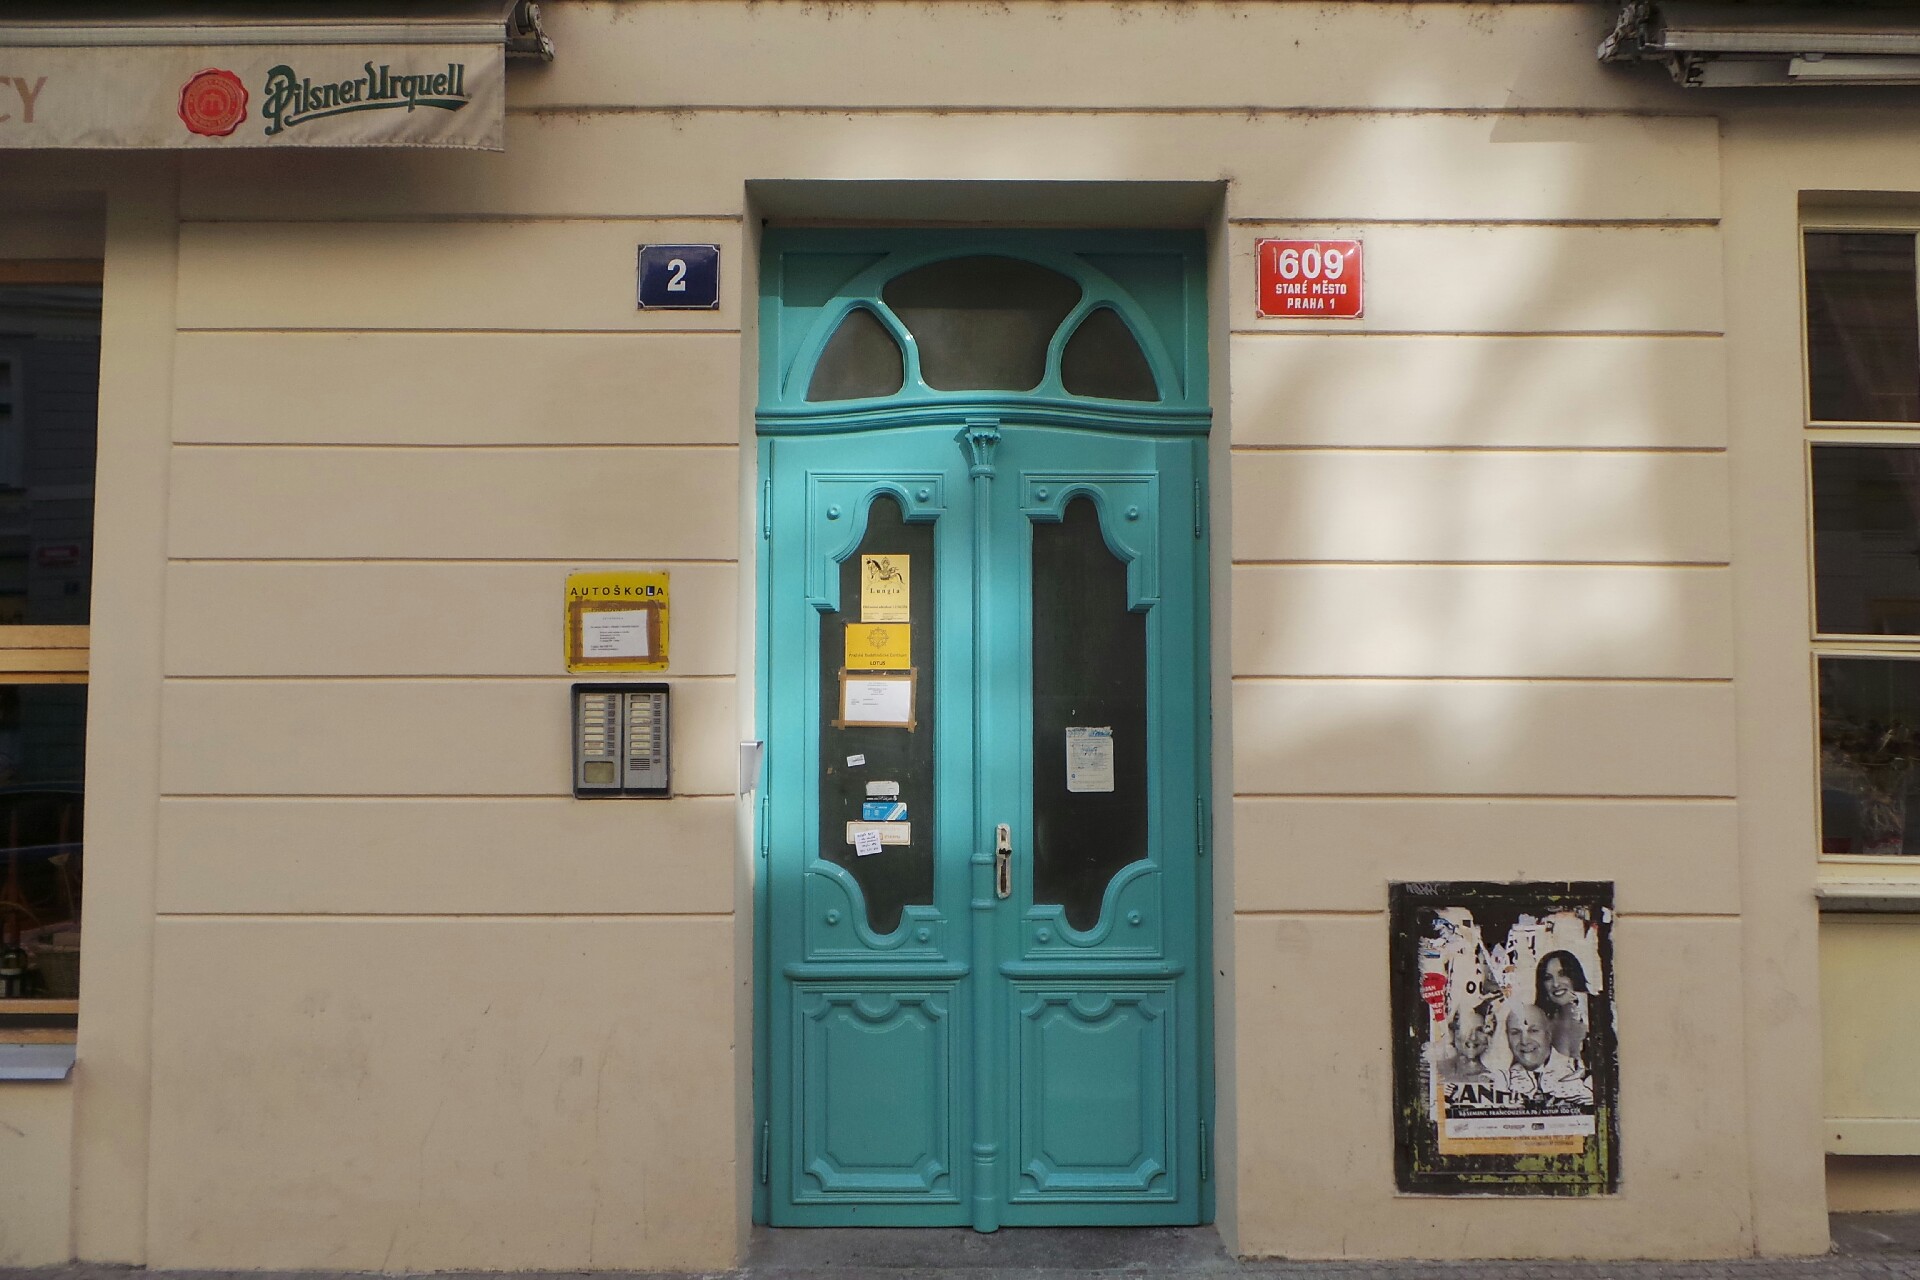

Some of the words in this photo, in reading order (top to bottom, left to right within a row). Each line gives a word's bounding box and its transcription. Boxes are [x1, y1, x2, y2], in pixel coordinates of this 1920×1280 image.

[261, 64, 370, 136] Pilsner
[364, 61, 466, 113] Urquell
[667, 258, 687, 292] 2
[1280, 248, 1344, 279] 609
[1275, 280, 1308, 295] STARÉ
[1312, 280, 1347, 295] MĚSTO
[1287, 298, 1324, 309] PRAHA
[1329, 298, 1335, 309] 1
[570, 585, 664, 596] AUTOŠKOLA
